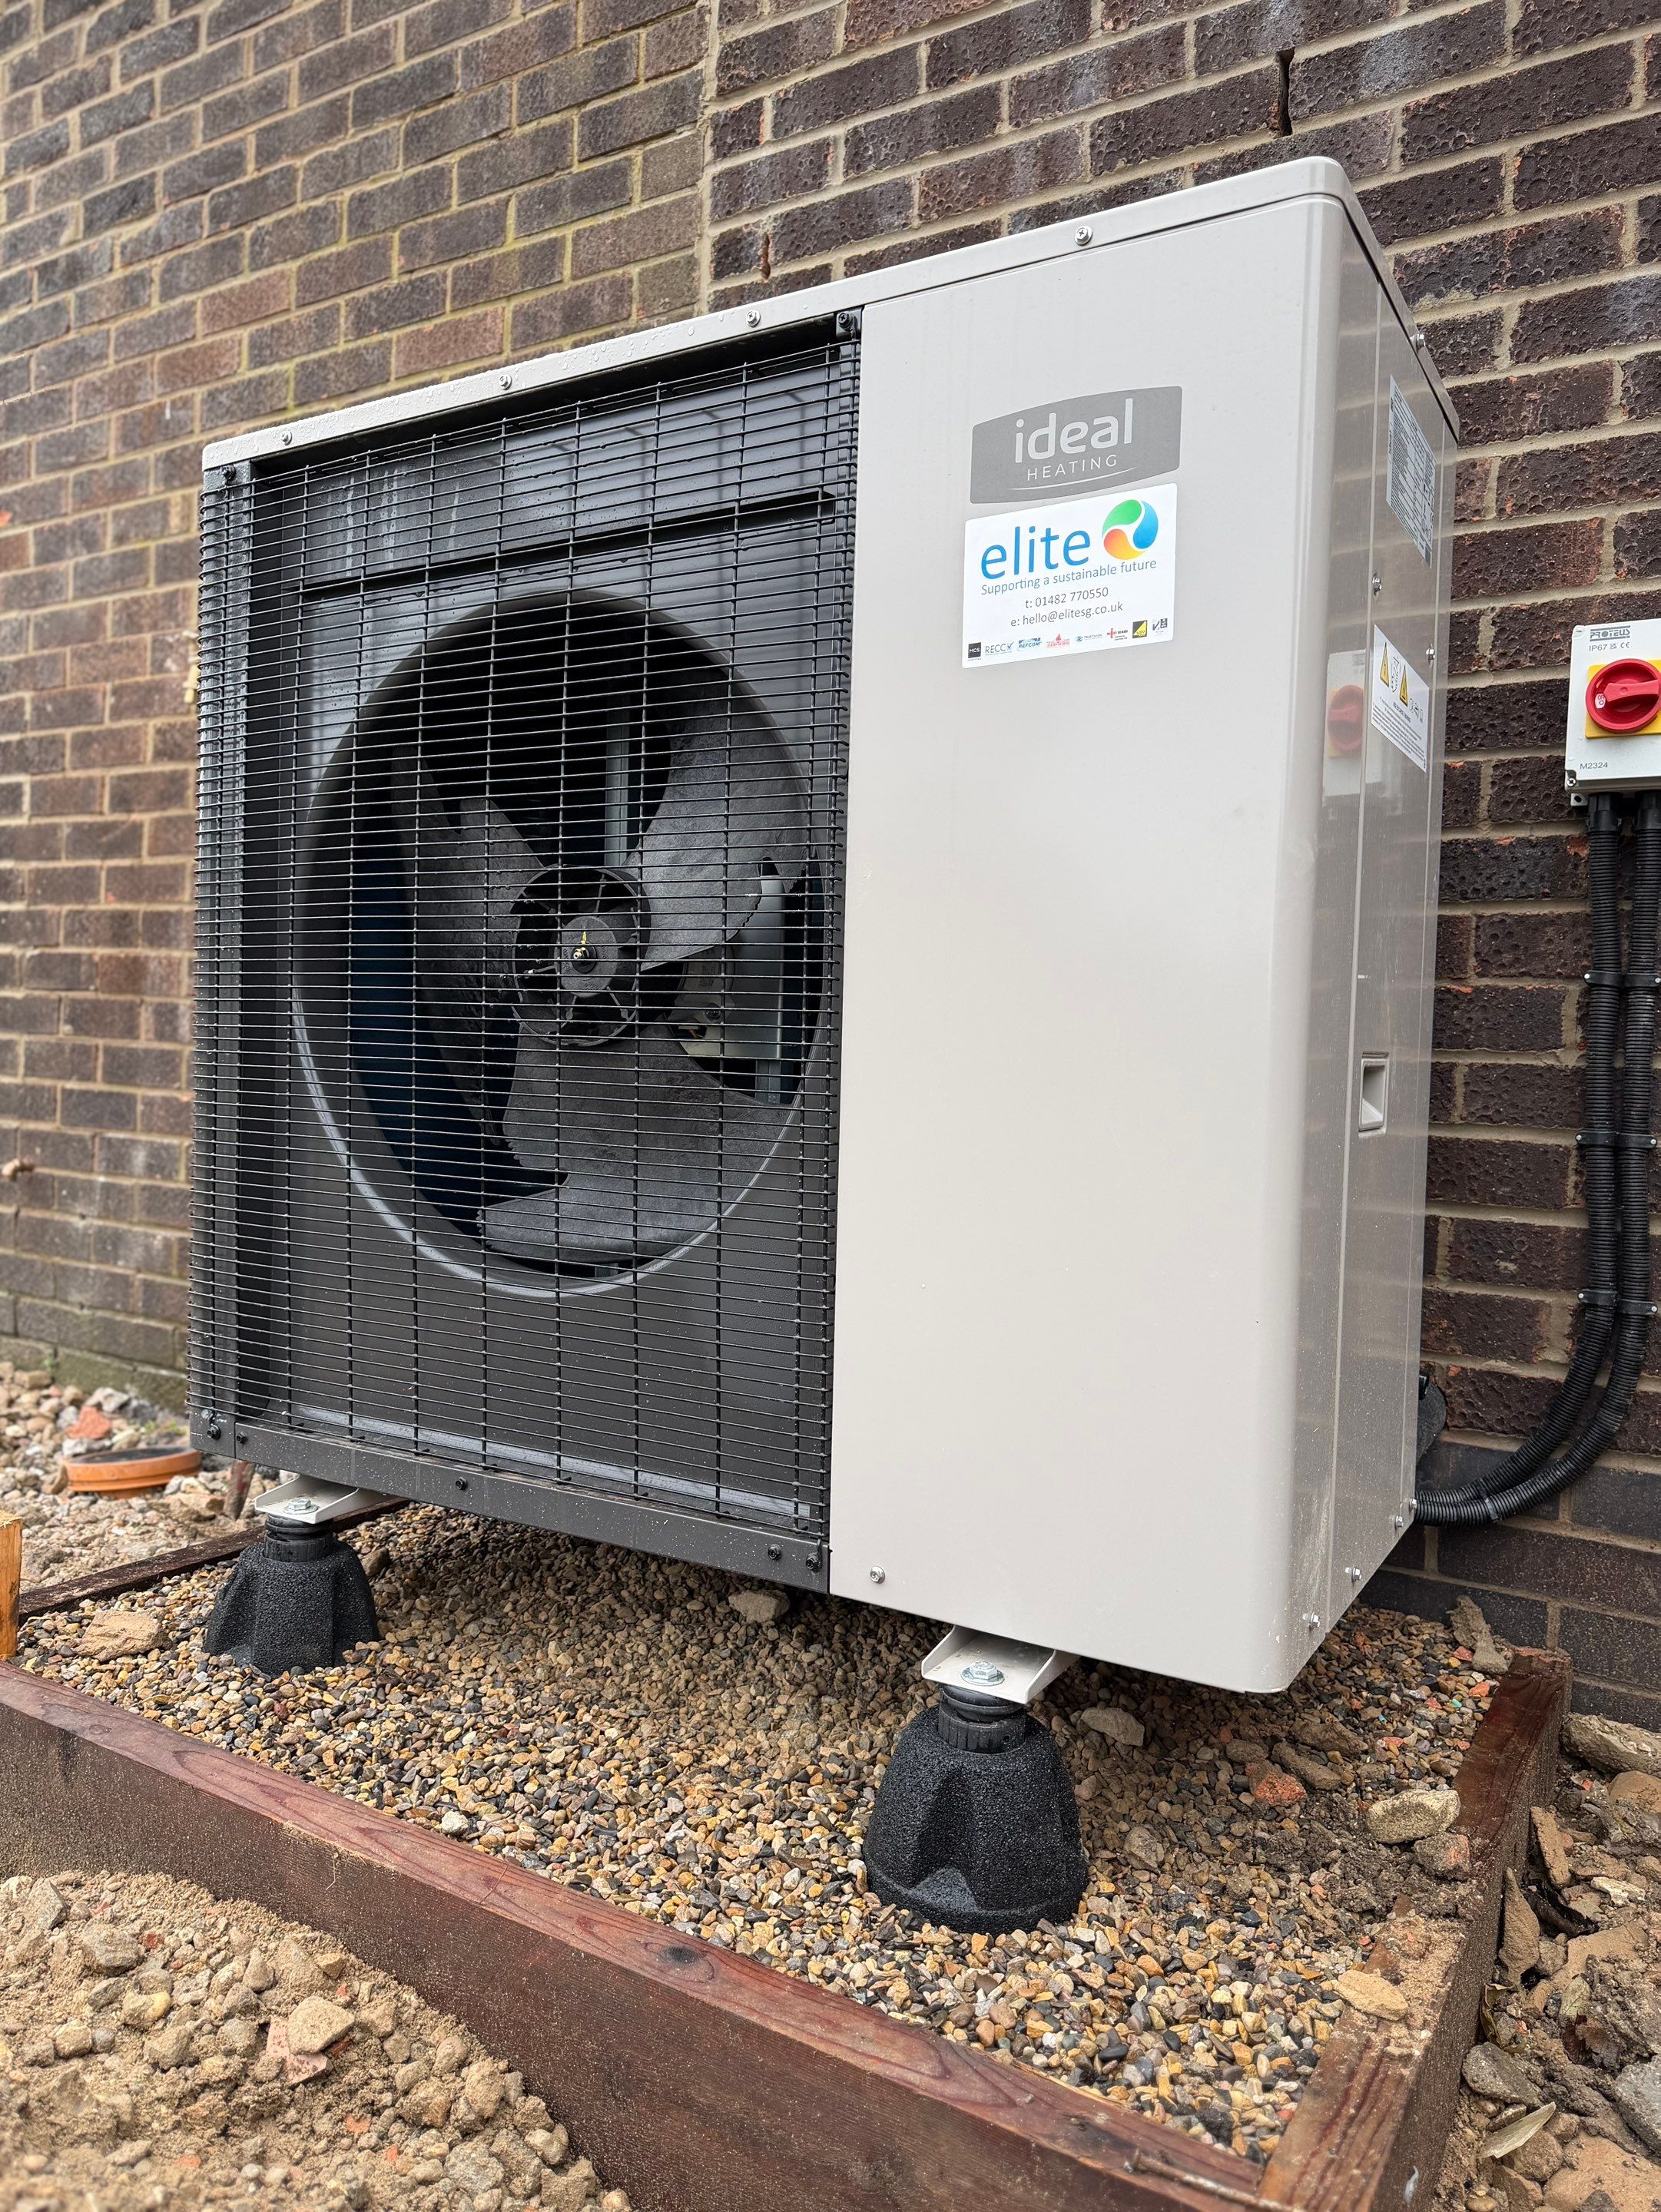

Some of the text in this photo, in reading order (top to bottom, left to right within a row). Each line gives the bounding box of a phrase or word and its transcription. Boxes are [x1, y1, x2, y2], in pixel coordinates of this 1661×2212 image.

[1015, 397, 1134, 463] ideal
[1027, 455, 1118, 481] HEATING
[980, 525, 1091, 580] elite
[981, 578, 1041, 596] Supporting
[1053, 565, 1117, 584] sustainable
[1120, 559, 1157, 574] future
[1025, 587, 1109, 609] t: 01482 770550
[1010, 601, 1124, 628] e: hello@elitesg.co.uk
[1590, 629, 1630, 638] PROTEUS
[1580, 761, 1608, 770] M2324
